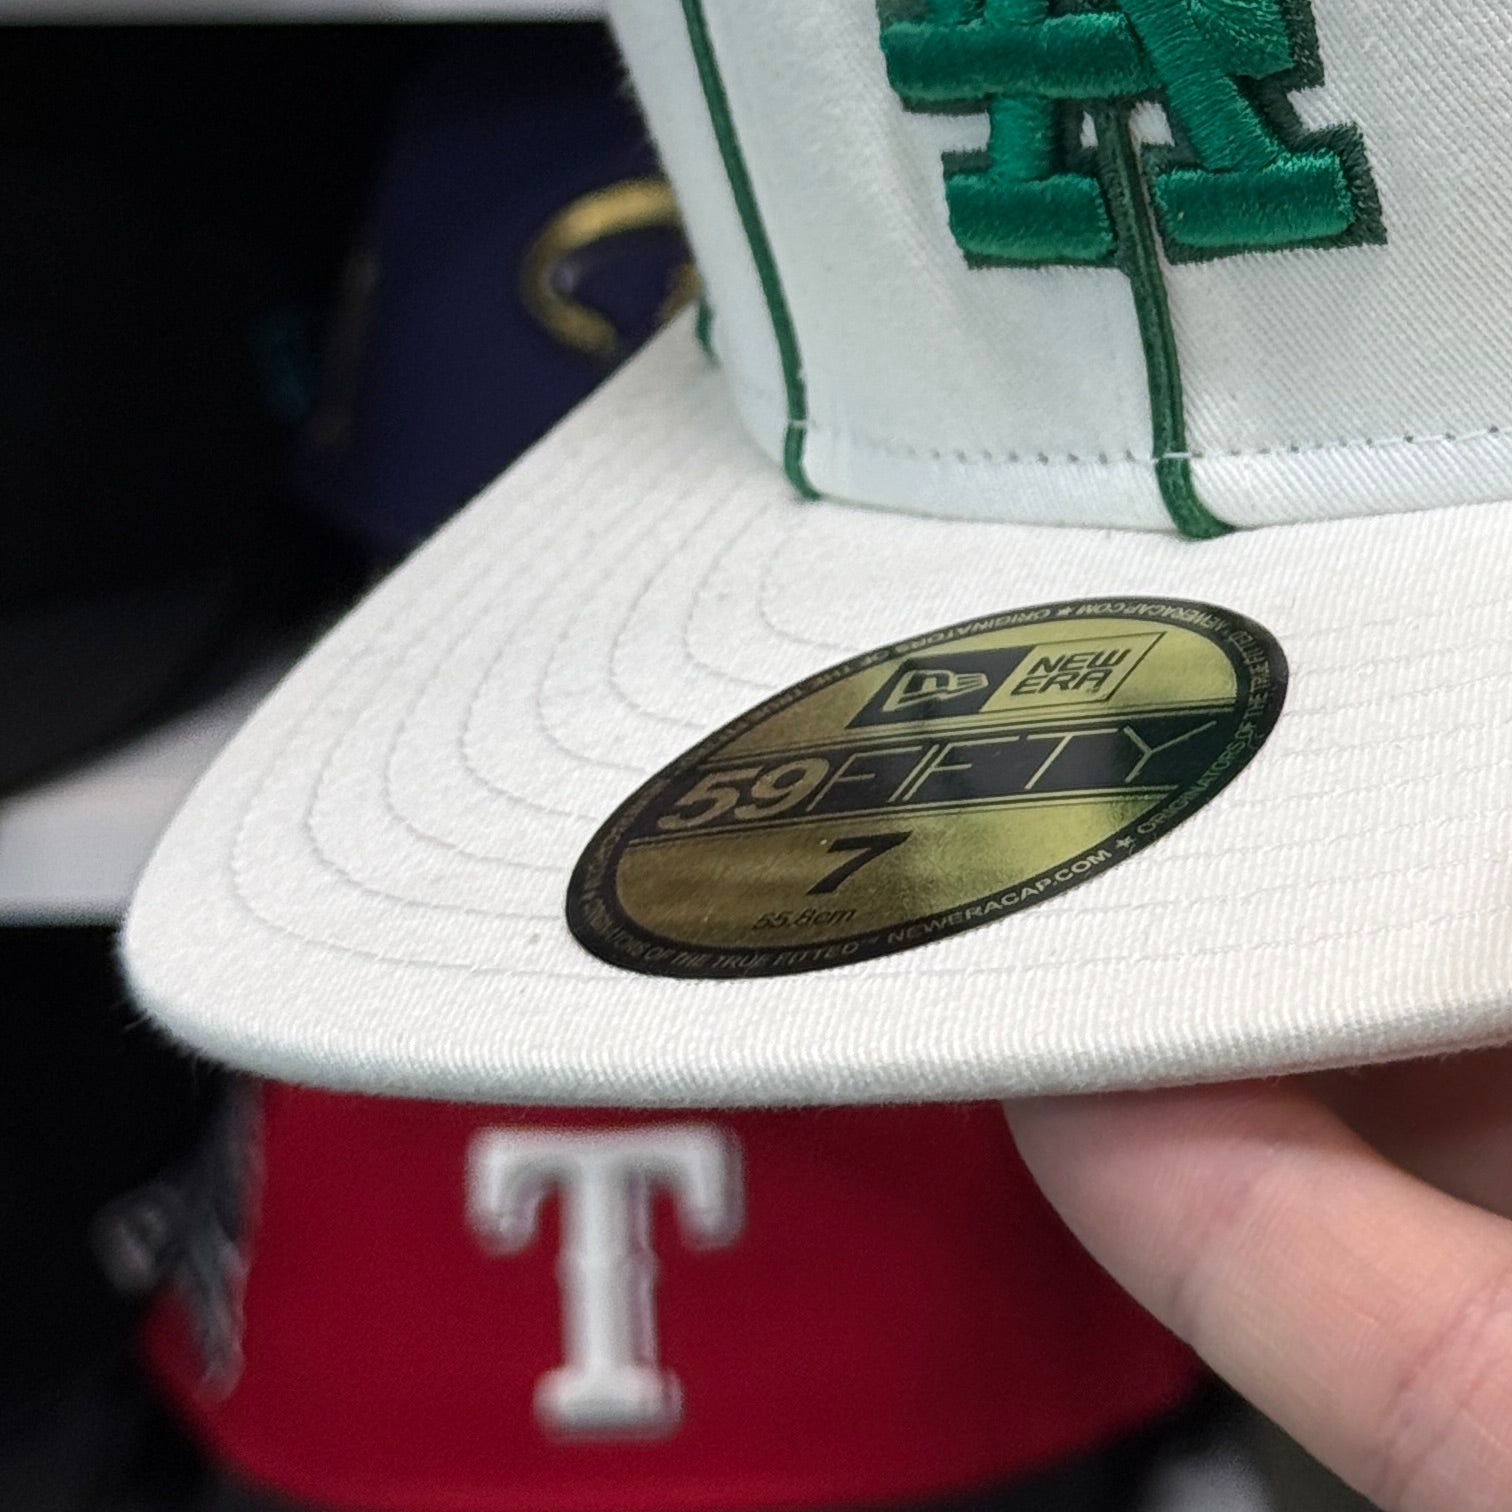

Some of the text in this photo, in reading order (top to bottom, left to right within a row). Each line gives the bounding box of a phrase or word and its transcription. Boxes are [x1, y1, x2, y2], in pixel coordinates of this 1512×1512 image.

[1010, 669, 1113, 696] ERA
[1027, 649, 1132, 675] NEW
[656, 721, 1216, 831] 59FIFTY
[805, 830, 913, 895] 7
[464, 1123, 746, 1441] T
